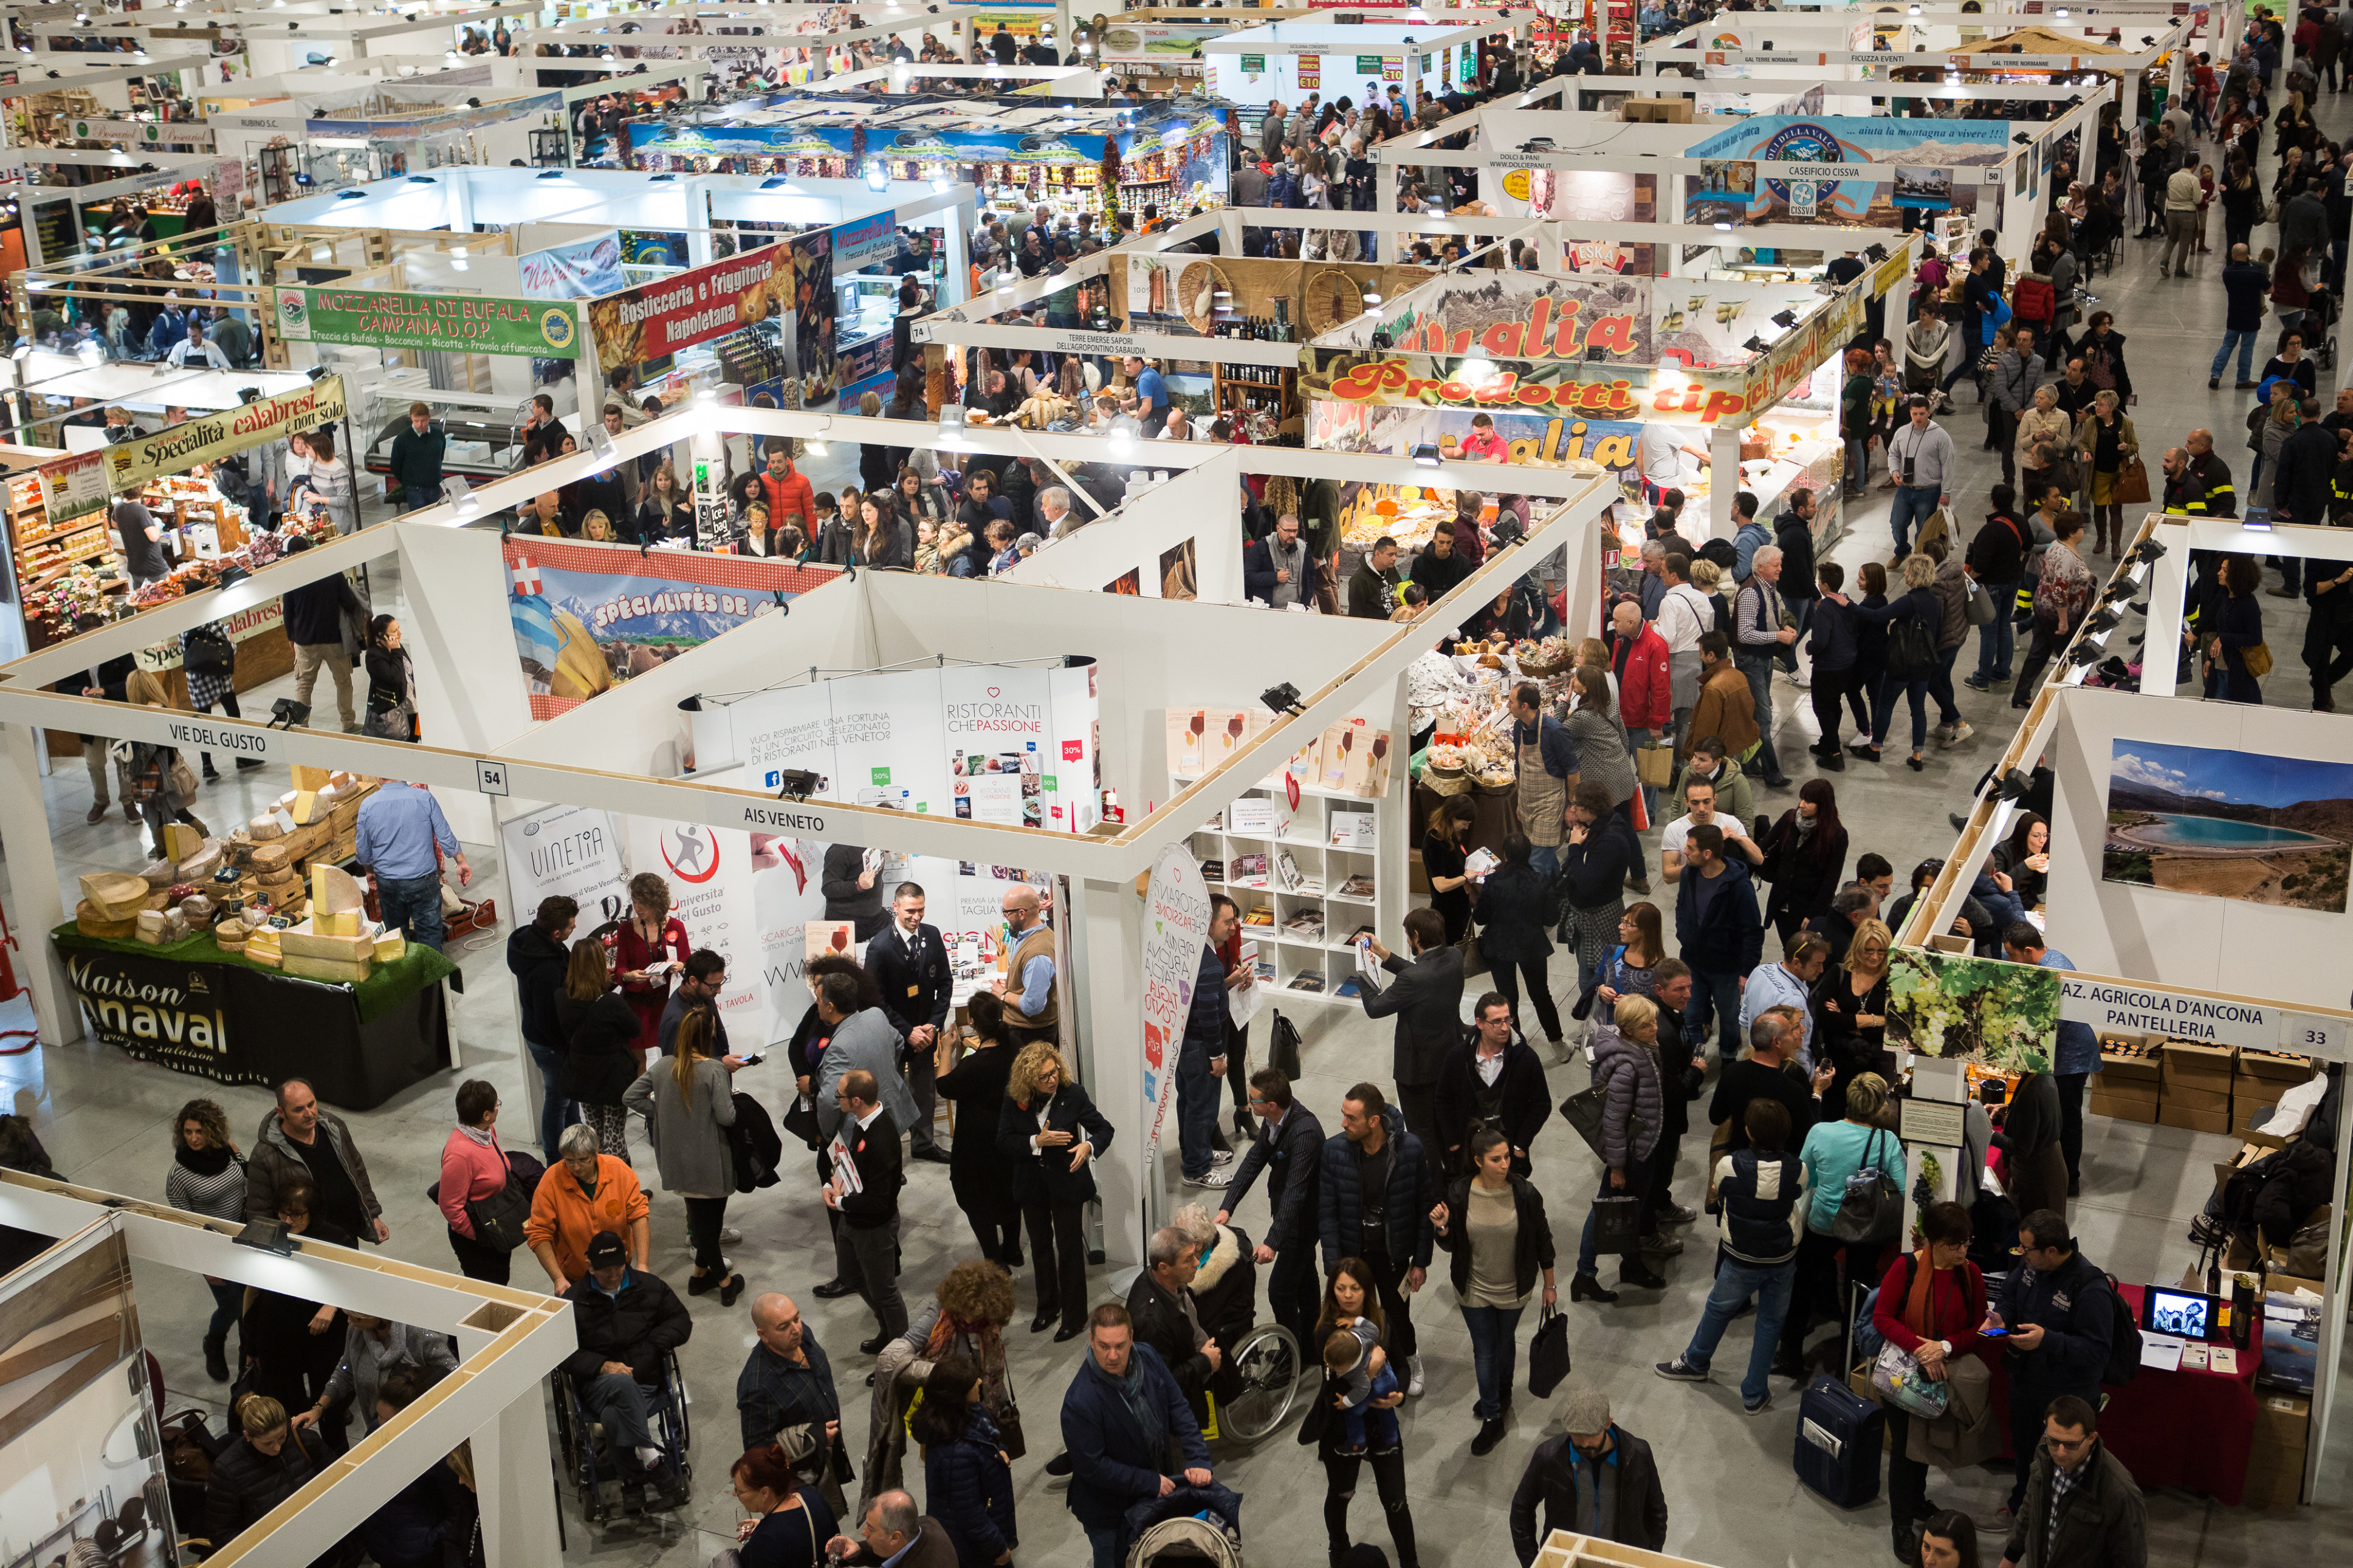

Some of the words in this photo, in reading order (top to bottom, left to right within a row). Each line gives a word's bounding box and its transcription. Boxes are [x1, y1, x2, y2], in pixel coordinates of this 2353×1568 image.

[1113, 64, 1125, 74] da
[1383, 70, 1402, 81] €10
[1299, 78, 1319, 88] €10
[1859, 126, 1883, 135] aiuta
[1886, 126, 1895, 135] la
[1898, 128, 1946, 139] montagna
[1958, 130, 1986, 139] vivere
[1060, 151, 1079, 159] Puglia
[1489, 161, 1551, 169] WWW.DOLCIEPANI.IT
[1789, 166, 1830, 176] CASEIFICIO
[1832, 168, 1860, 177] CISSVA
[1988, 172, 1998, 181] 50
[1790, 205, 1815, 216] CISSVA
[837, 218, 882, 250] Mozzarella
[1578, 244, 1615, 264] ESKA
[619, 287, 694, 326] Rosticceria
[698, 282, 707, 300] e
[711, 259, 772, 298] Friggitoria
[318, 292, 431, 316] MOZZARELLA
[436, 299, 458, 318] DI
[463, 300, 532, 323] BUFALA
[358, 313, 441, 338] CAMPANA
[447, 318, 494, 341] D.O.P.
[666, 303, 737, 343] Napoletana
[913, 328, 924, 337] 74
[1068, 334, 1086, 343] TERRE
[1087, 335, 1110, 343] EMERSE
[1111, 336, 1133, 345] SAPORI
[312, 329, 340, 341] Treccia
[342, 330, 349, 341] di
[352, 332, 377, 345] Bufala
[385, 334, 424, 347] Bocconcini
[431, 337, 463, 349] Ricotta
[470, 340, 500, 352] Provola
[501, 341, 548, 355] affumicata
[1056, 342, 1114, 353] DELL'AGROPONTINO
[1115, 345, 1146, 355] SABAUDIA
[1331, 358, 1633, 410] Prodotti
[1653, 366, 1769, 424] tipici
[285, 423, 290, 435] e
[294, 413, 315, 431] non
[320, 402, 343, 422] solo
[142, 420, 224, 467] Specialità
[713, 519, 728, 534] bag
[594, 586, 718, 628] SPÉCIALITÉS
[722, 594, 749, 616] DE
[947, 703, 1042, 720] RISTORANTI
[749, 733, 770, 745] VUOI
[774, 721, 820, 739] RISPARMIARE
[823, 717, 844, 727] UNA
[848, 712, 890, 723] FORTUNA
[948, 720, 1042, 733] CHEPASSIONE
[170, 724, 191, 743] VIE
[193, 727, 218, 746] DEL
[220, 730, 266, 752] GUSTO
[751, 746, 761, 755] IN
[766, 742, 780, 751] UN
[785, 730, 823, 745] CIRCUITO
[829, 721, 891, 735] SELEZIONATO
[752, 755, 761, 765] DI
[764, 741, 817, 762] RISTORANTI
[820, 736, 841, 747] NEL
[843, 731, 891, 744] VENETO?
[484, 771, 501, 786] 54
[744, 808, 765, 824] AIS
[768, 811, 825, 832] VENETO
[540, 878, 555, 887] GUIDA
[583, 861, 600, 872] VENETO
[527, 907, 536, 916] La
[583, 883, 597, 893] Vino
[598, 877, 619, 889] Veneto
[692, 903, 721, 919] Gusto
[961, 905, 995, 917] TAGLIA
[761, 928, 801, 945] SCARICA
[761, 943, 778, 952] TUTTO
[66, 954, 187, 1006] Maison
[725, 993, 754, 1010] TAVOLA
[2062, 982, 2087, 1001] AZ.
[2090, 985, 2171, 1012] AGRICOLA
[2175, 993, 2264, 1025] D'ANCONA
[2106, 1009, 2216, 1039] PANTELLERIA
[2306, 1029, 2327, 1046] 33
[157, 1045, 215, 1063] salaison
[208, 1067, 269, 1084] Maurice
